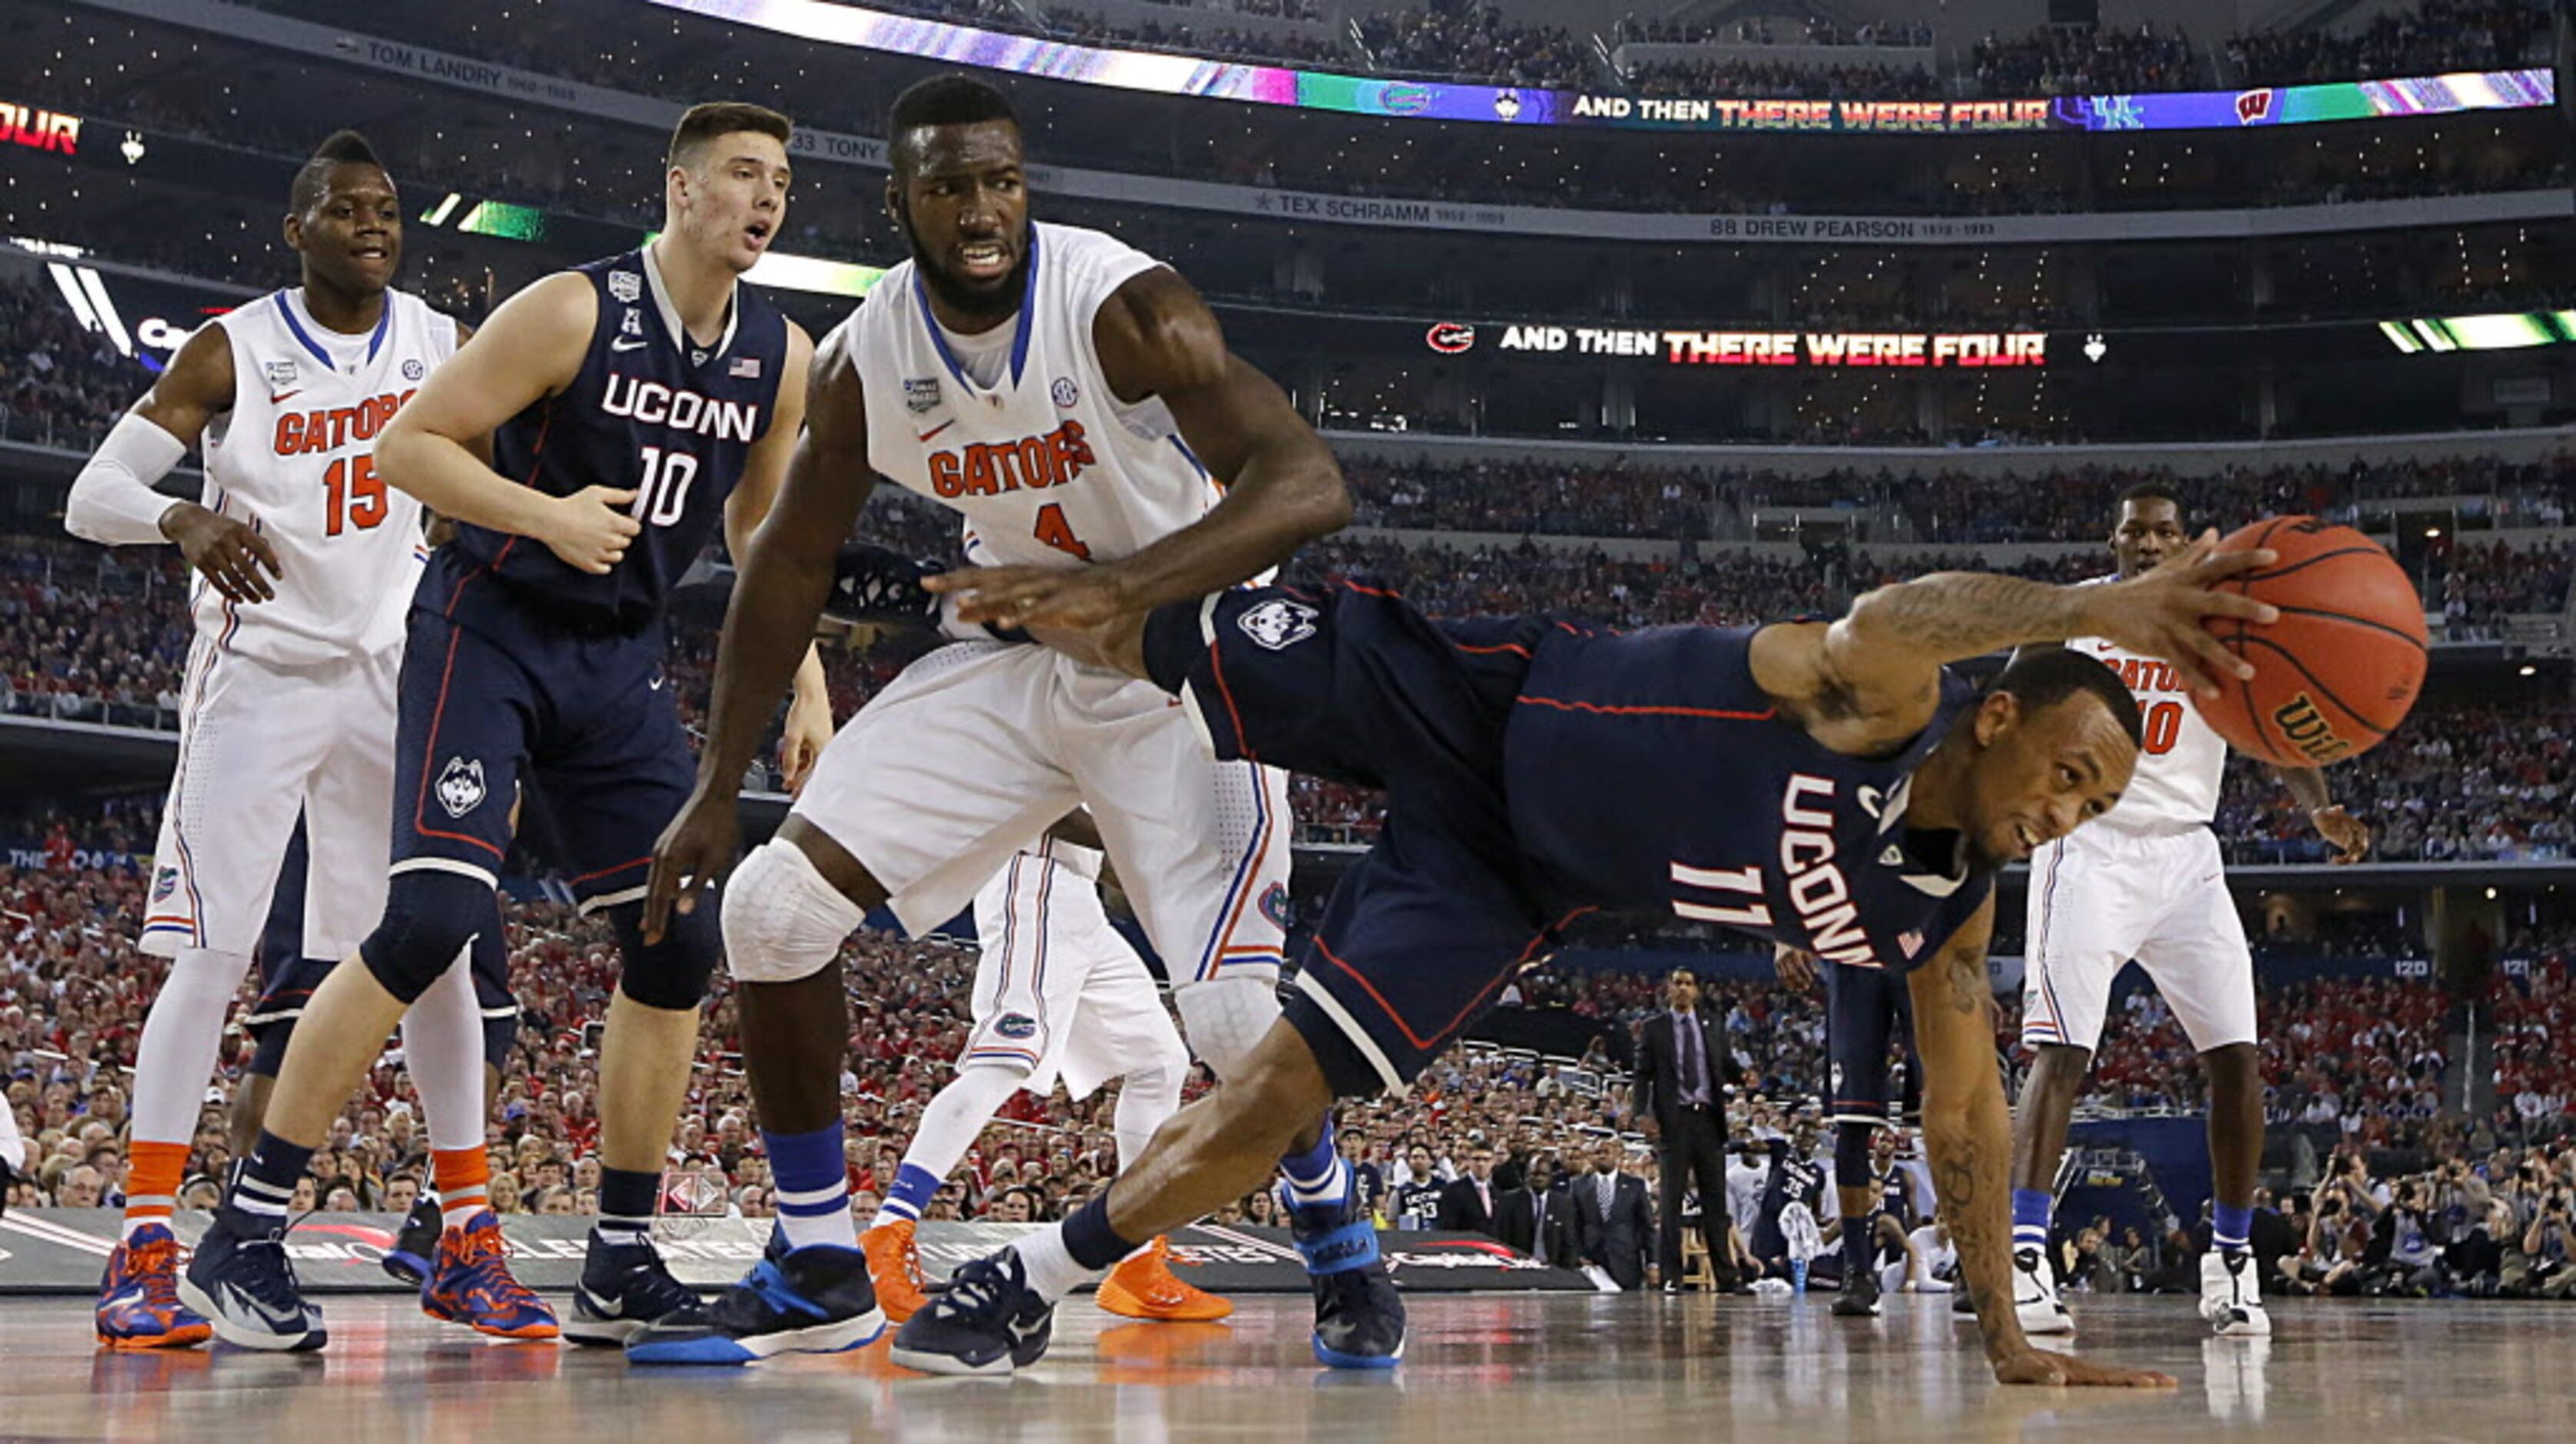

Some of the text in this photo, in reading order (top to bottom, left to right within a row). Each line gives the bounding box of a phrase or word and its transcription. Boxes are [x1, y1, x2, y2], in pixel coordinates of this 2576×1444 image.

[368, 42, 412, 68] TOM
[420, 58, 502, 88] LANDRY
[0, 101, 80, 155] OUR
[1573, 95, 2048, 131] AND THEN THERE WERE FOUR
[792, 131, 880, 159] 33 TONY
[1280, 195, 1319, 214] TEX
[1326, 199, 1429, 221] SCHRAMM
[1710, 219, 1737, 235] 88
[1746, 220, 1807, 236] DREW
[1814, 221, 1914, 238] PEARSON
[1500, 325, 2047, 366] AND THEN THERE WERE FOUR
[601, 372, 757, 443] UCONN
[631, 446, 698, 527] 10
[928, 419, 1097, 498] GATORS
[322, 454, 388, 537] 15
[1033, 502, 1097, 563] 4
[2273, 690, 2350, 760] Wil
[1669, 860, 1774, 926] 11
[1780, 772, 1885, 969] UCONN
[2394, 960, 2429, 977] 120
